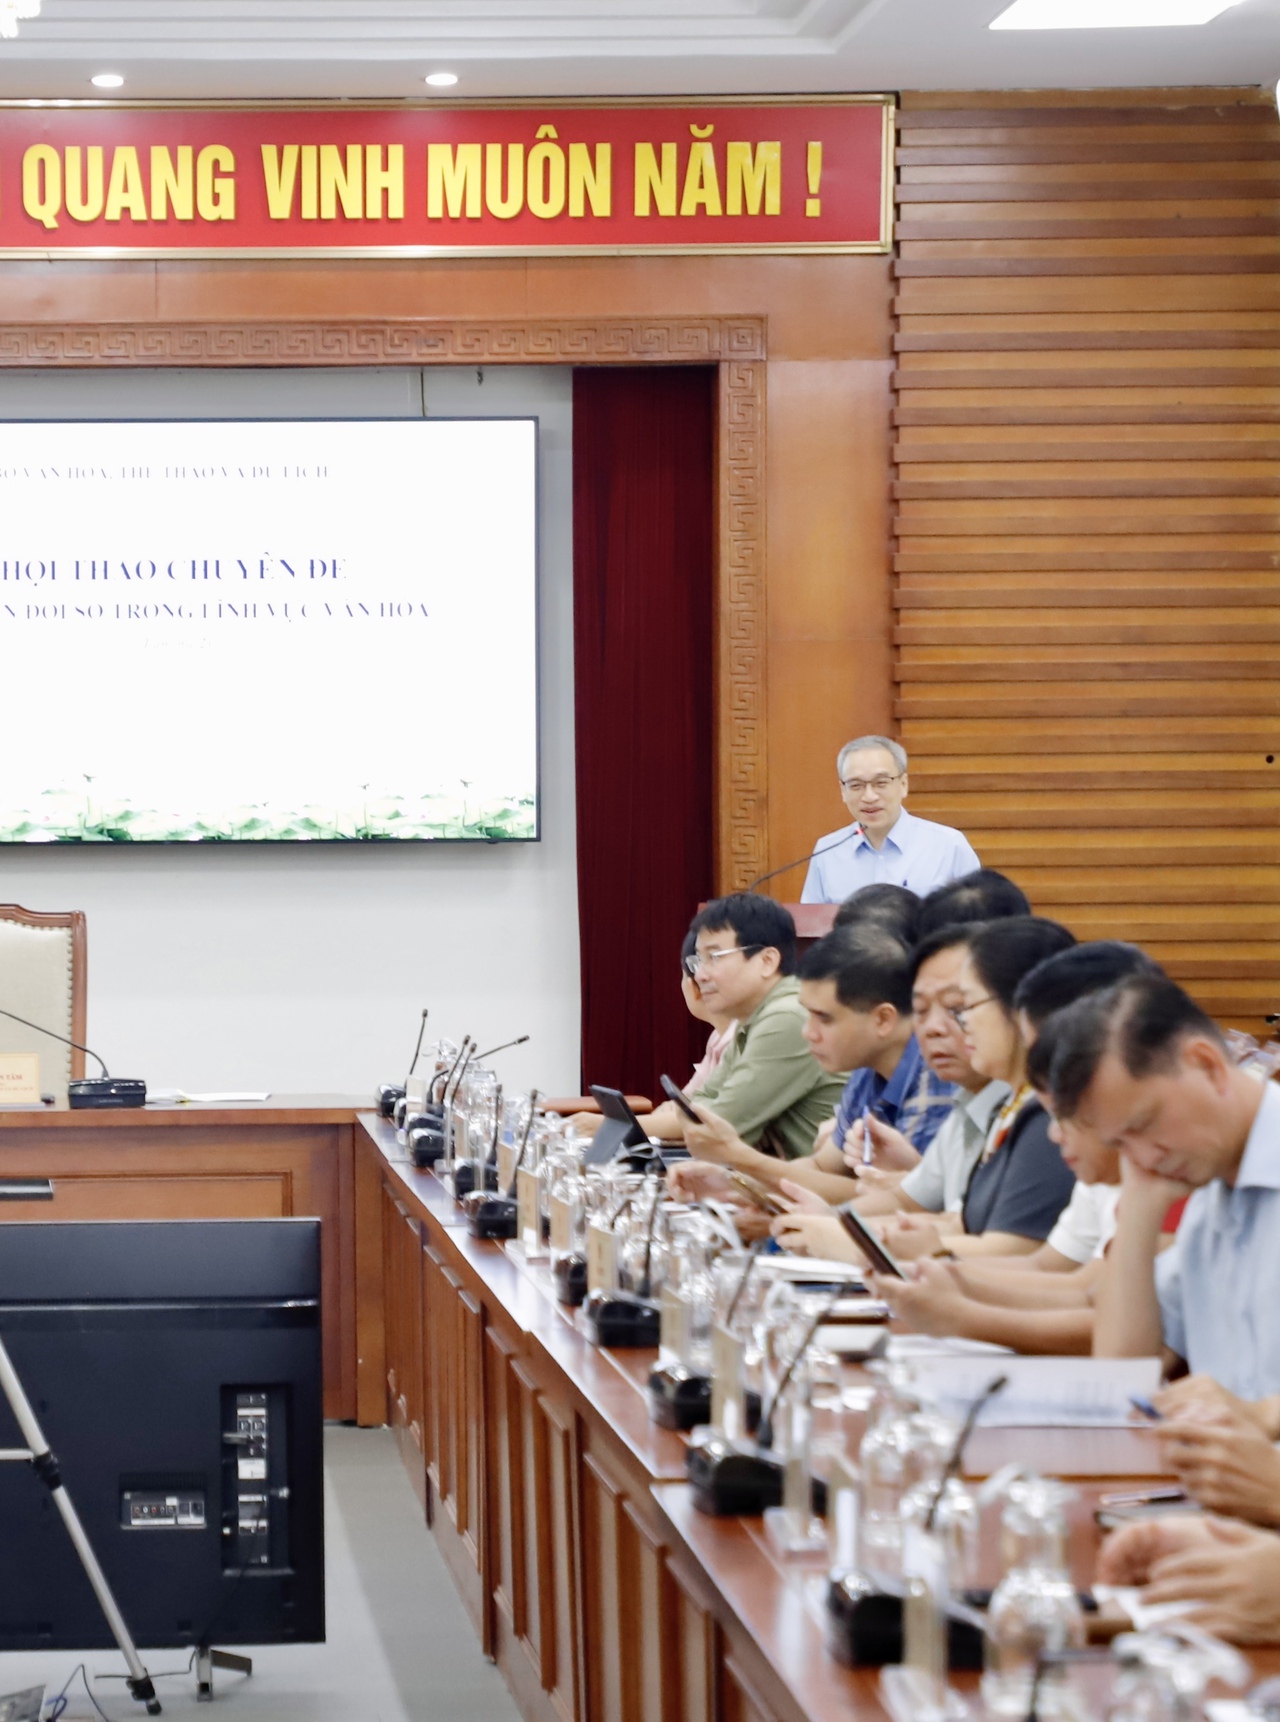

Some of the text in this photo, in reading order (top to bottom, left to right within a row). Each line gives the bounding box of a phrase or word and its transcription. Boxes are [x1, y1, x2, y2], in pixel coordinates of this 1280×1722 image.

[22, 143, 236, 229] QUANG
[261, 143, 405, 221] VINH
[427, 124, 613, 219] MUÔN
[634, 123, 782, 217] NĂM
[805, 141, 823, 218] !
